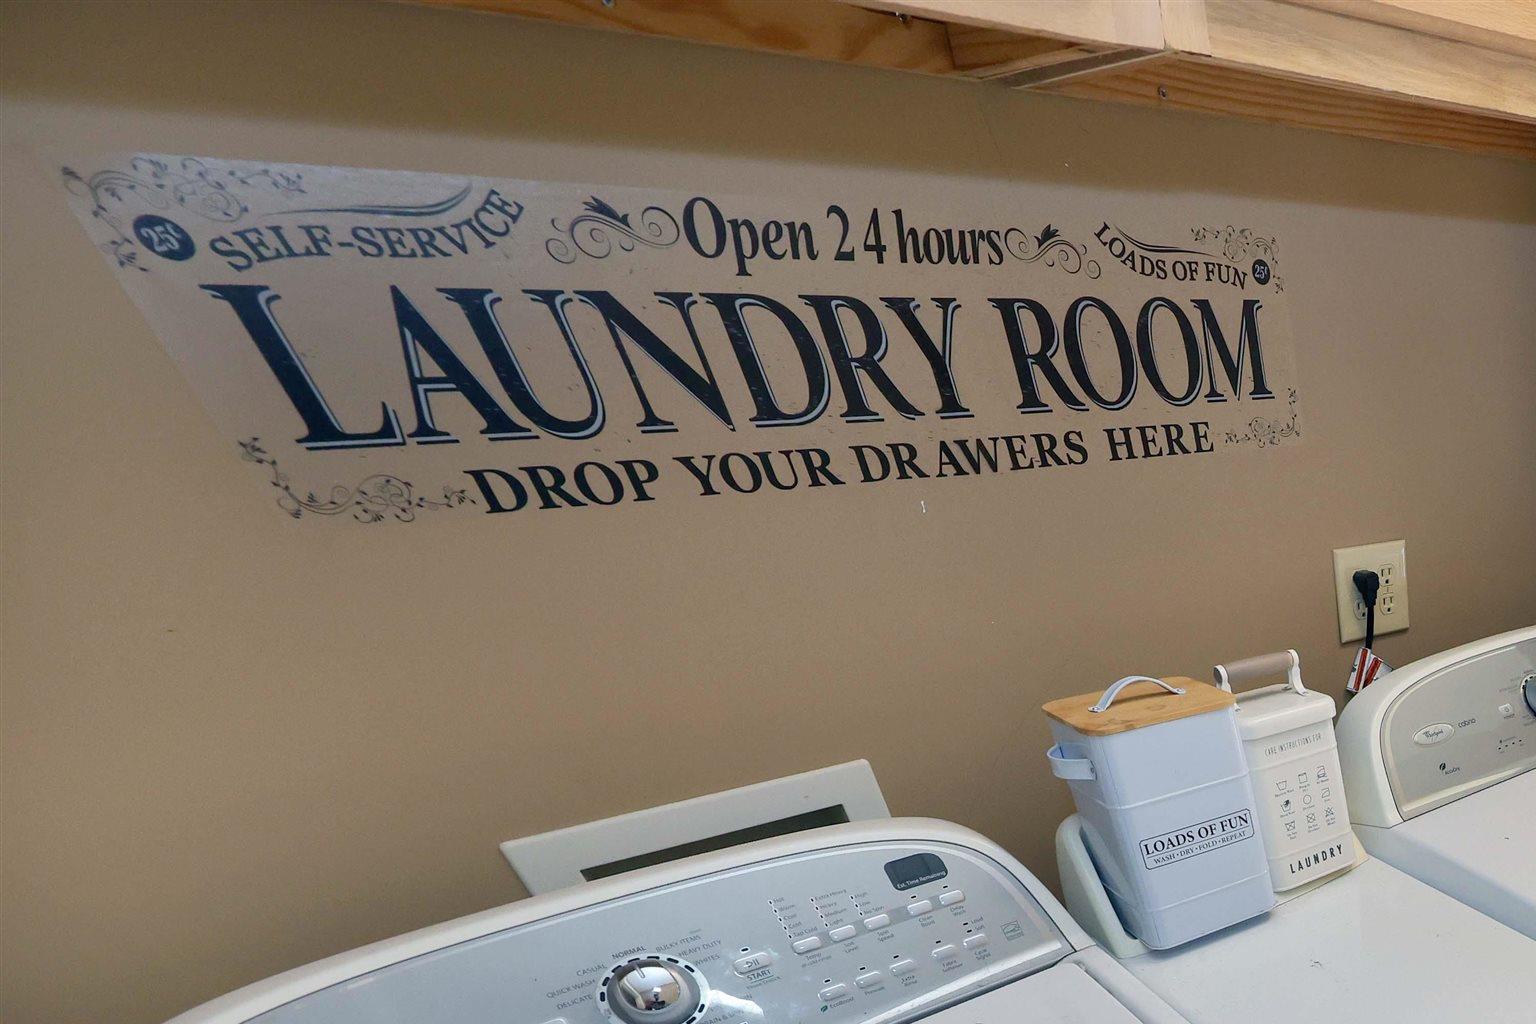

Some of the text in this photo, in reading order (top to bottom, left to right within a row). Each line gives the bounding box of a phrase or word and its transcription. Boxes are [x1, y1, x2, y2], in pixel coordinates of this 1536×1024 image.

[209, 188, 526, 273] SELF-SERVICE
[683, 197, 1005, 276] Open 24 hours
[1094, 221, 1248, 291] LOADS OF FUN
[198, 283, 1276, 451] LAUNDRY ROOM
[462, 420, 1216, 515] DROP YOUR DRAWERS HERE
[1143, 812, 1249, 856] LOADS OF FUN
[1153, 831, 1246, 864] WASH DRY FOLD REPEAT
[1289, 844, 1342, 874] LAUNDRY
[611, 945, 647, 960] NORMAL
[655, 934, 702, 953] BULKY ITEMS
[678, 939, 722, 958] HEAVY DUTY
[576, 963, 608, 977] CASUAL
[746, 968, 772, 981] START
[546, 978, 596, 1000] QUICK WASH
[556, 994, 593, 1011] DELICATE
